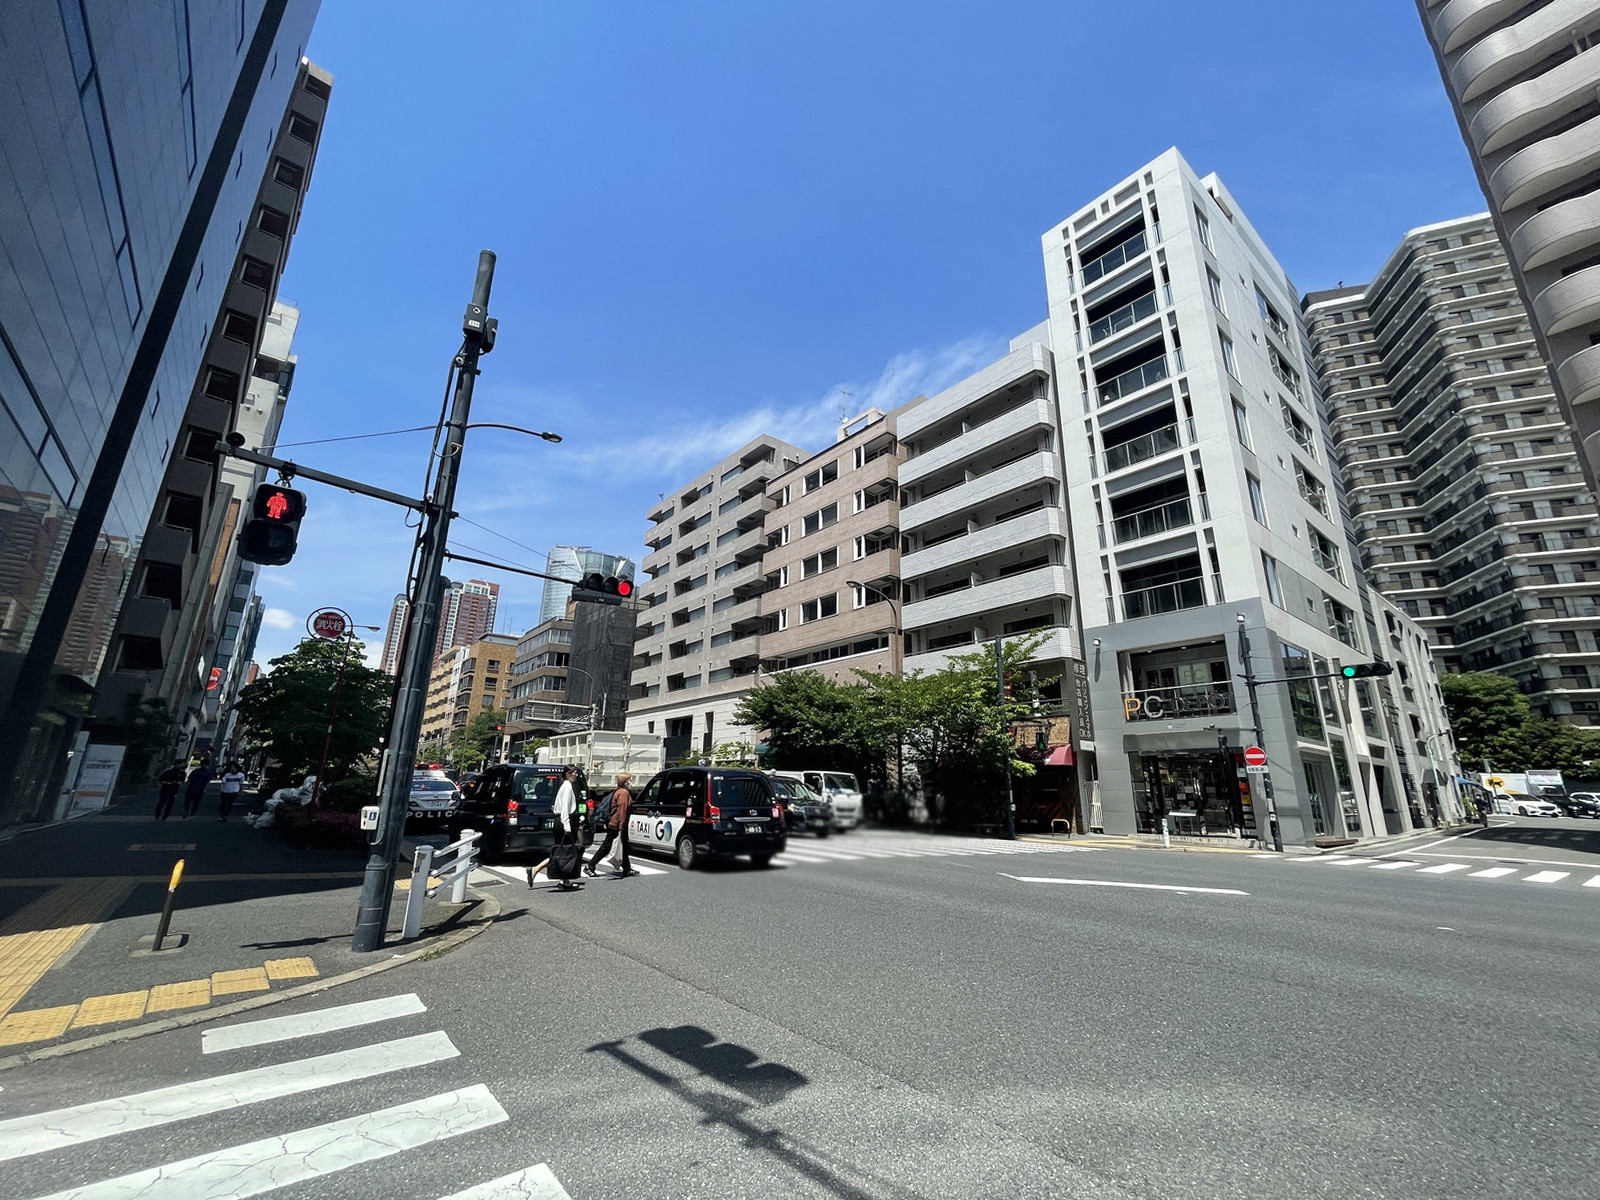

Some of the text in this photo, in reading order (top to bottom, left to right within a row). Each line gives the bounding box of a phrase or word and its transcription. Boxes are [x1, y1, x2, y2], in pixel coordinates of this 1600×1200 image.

[316, 619, 344, 631] 消火栓
[1124, 695, 1163, 720] PC
[406, 810, 458, 818] POLIC
[636, 821, 650, 834] TAXI
[655, 820, 673, 842] GO
